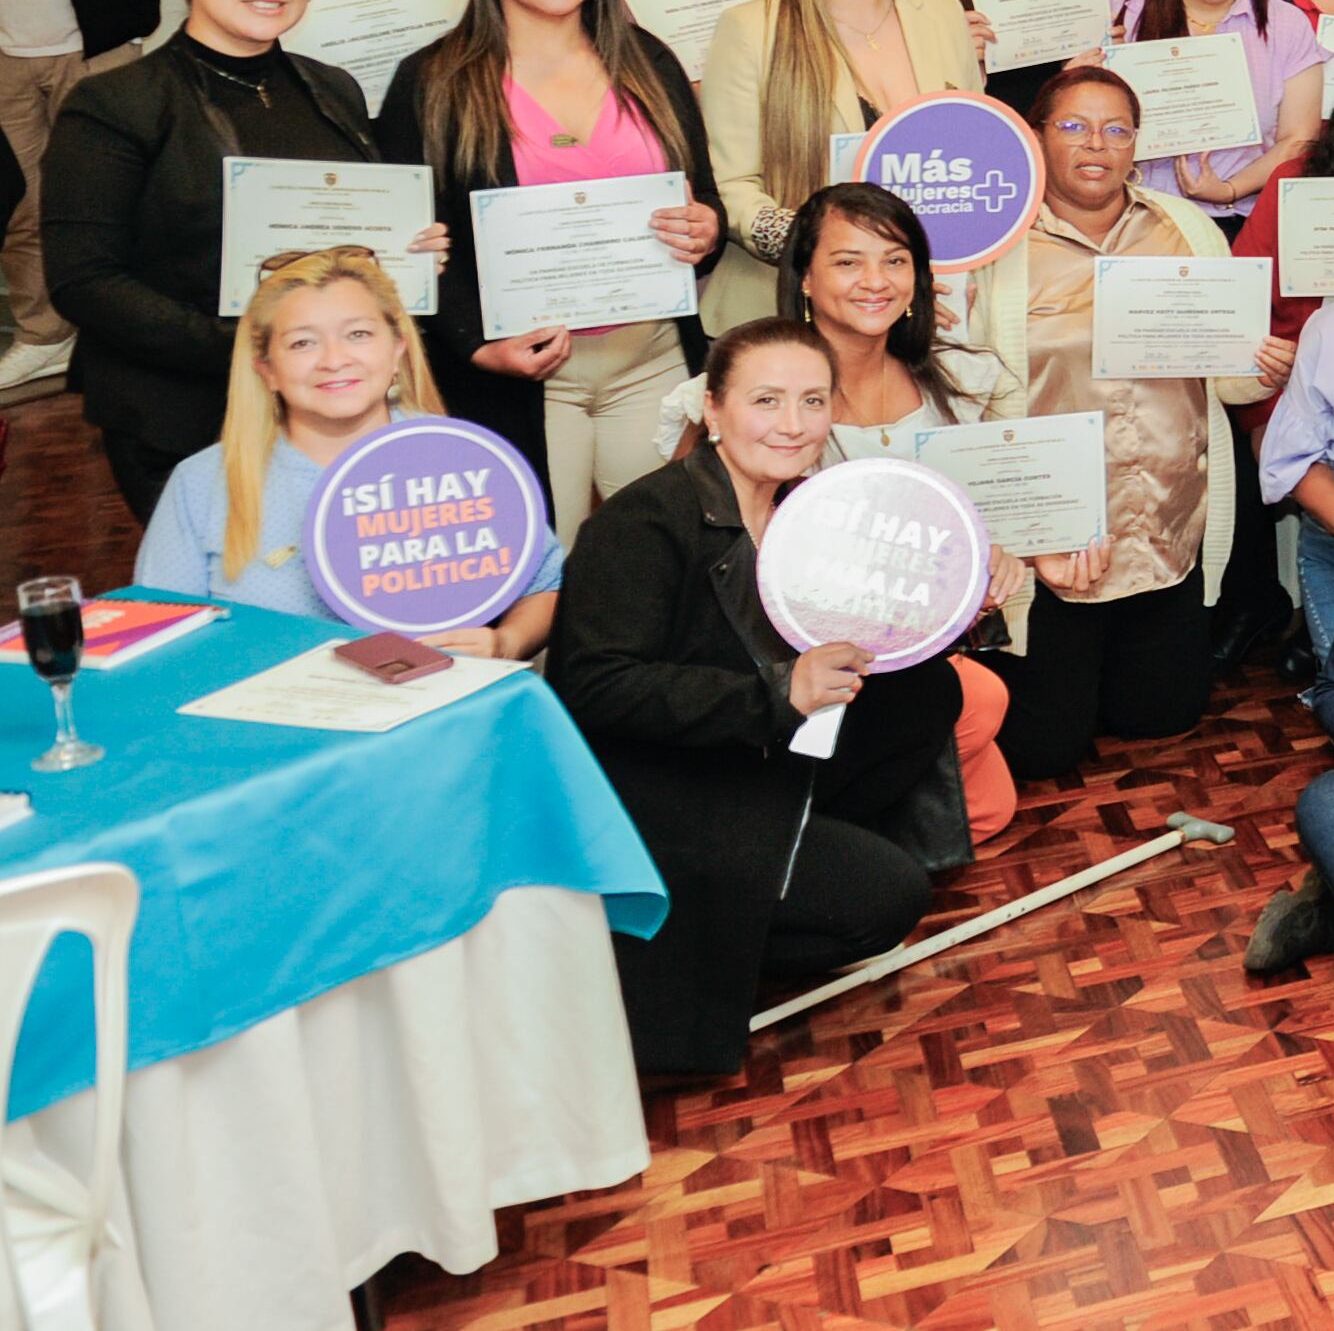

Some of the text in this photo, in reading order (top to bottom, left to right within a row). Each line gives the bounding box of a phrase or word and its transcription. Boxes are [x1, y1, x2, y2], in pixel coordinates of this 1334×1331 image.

[881, 149, 973, 184] Más
[342, 469, 490, 516] ¡SÍ HAY
[356, 497, 496, 538] MUJERES
[870, 512, 951, 553] HAY
[359, 527, 498, 570] PARA LA
[362, 547, 512, 597] POLÍTICA!
[892, 577, 930, 606] LA
